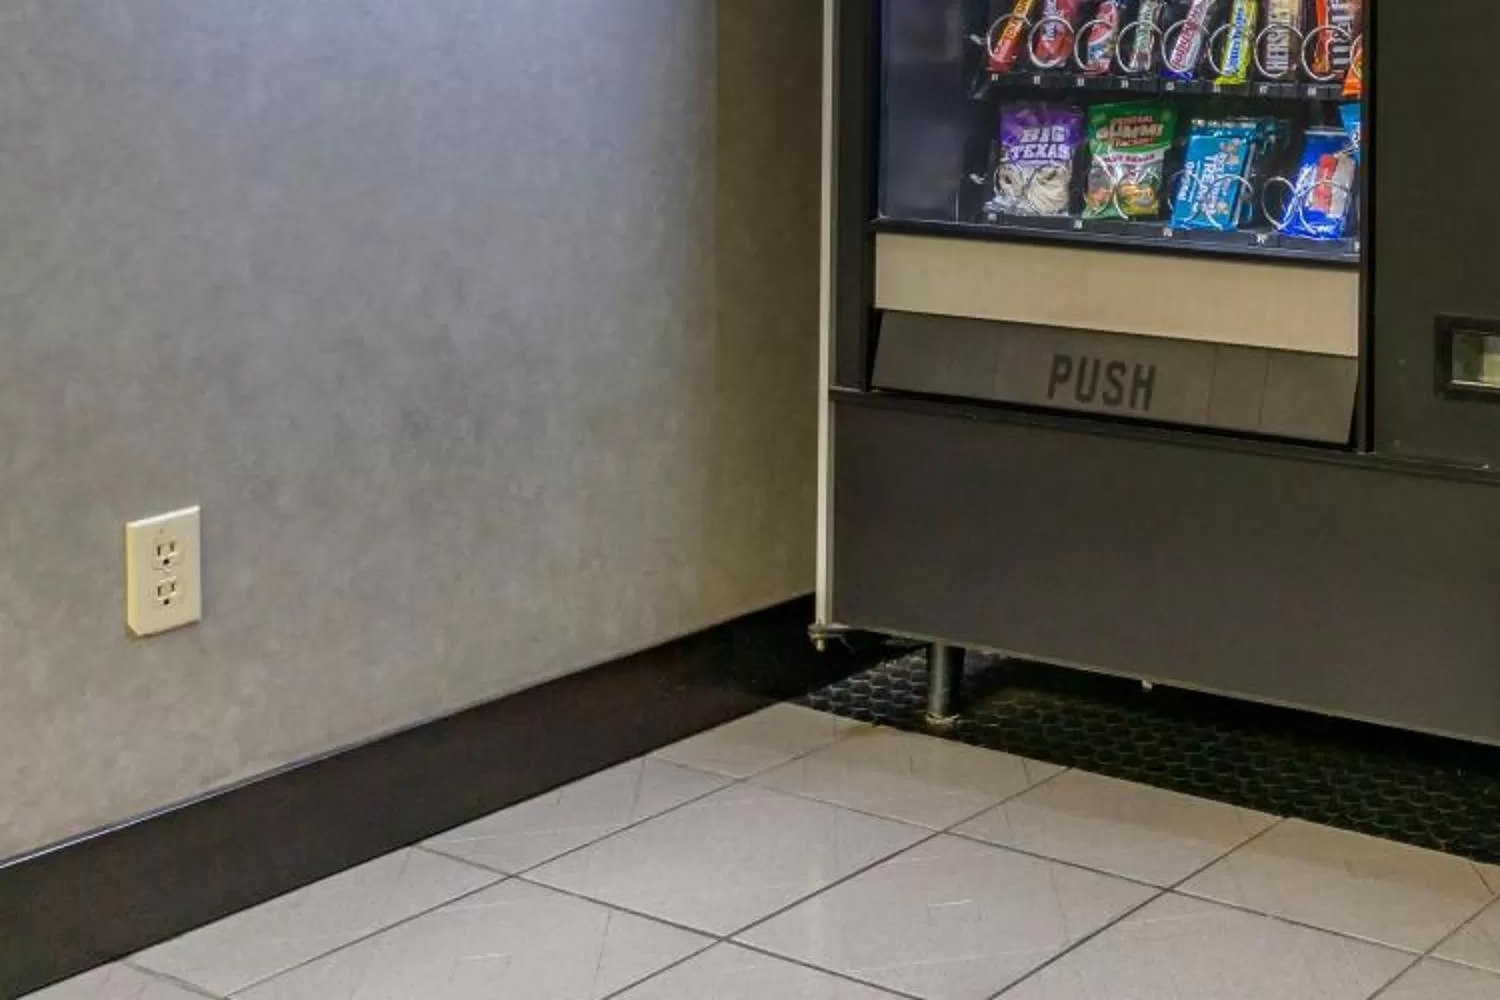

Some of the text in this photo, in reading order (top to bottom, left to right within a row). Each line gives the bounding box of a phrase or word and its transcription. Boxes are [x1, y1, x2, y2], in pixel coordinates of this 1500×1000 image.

[1020, 126, 1066, 143] BIG
[1005, 143, 1071, 161] TEXAS
[1047, 353, 1157, 412] PUSH
